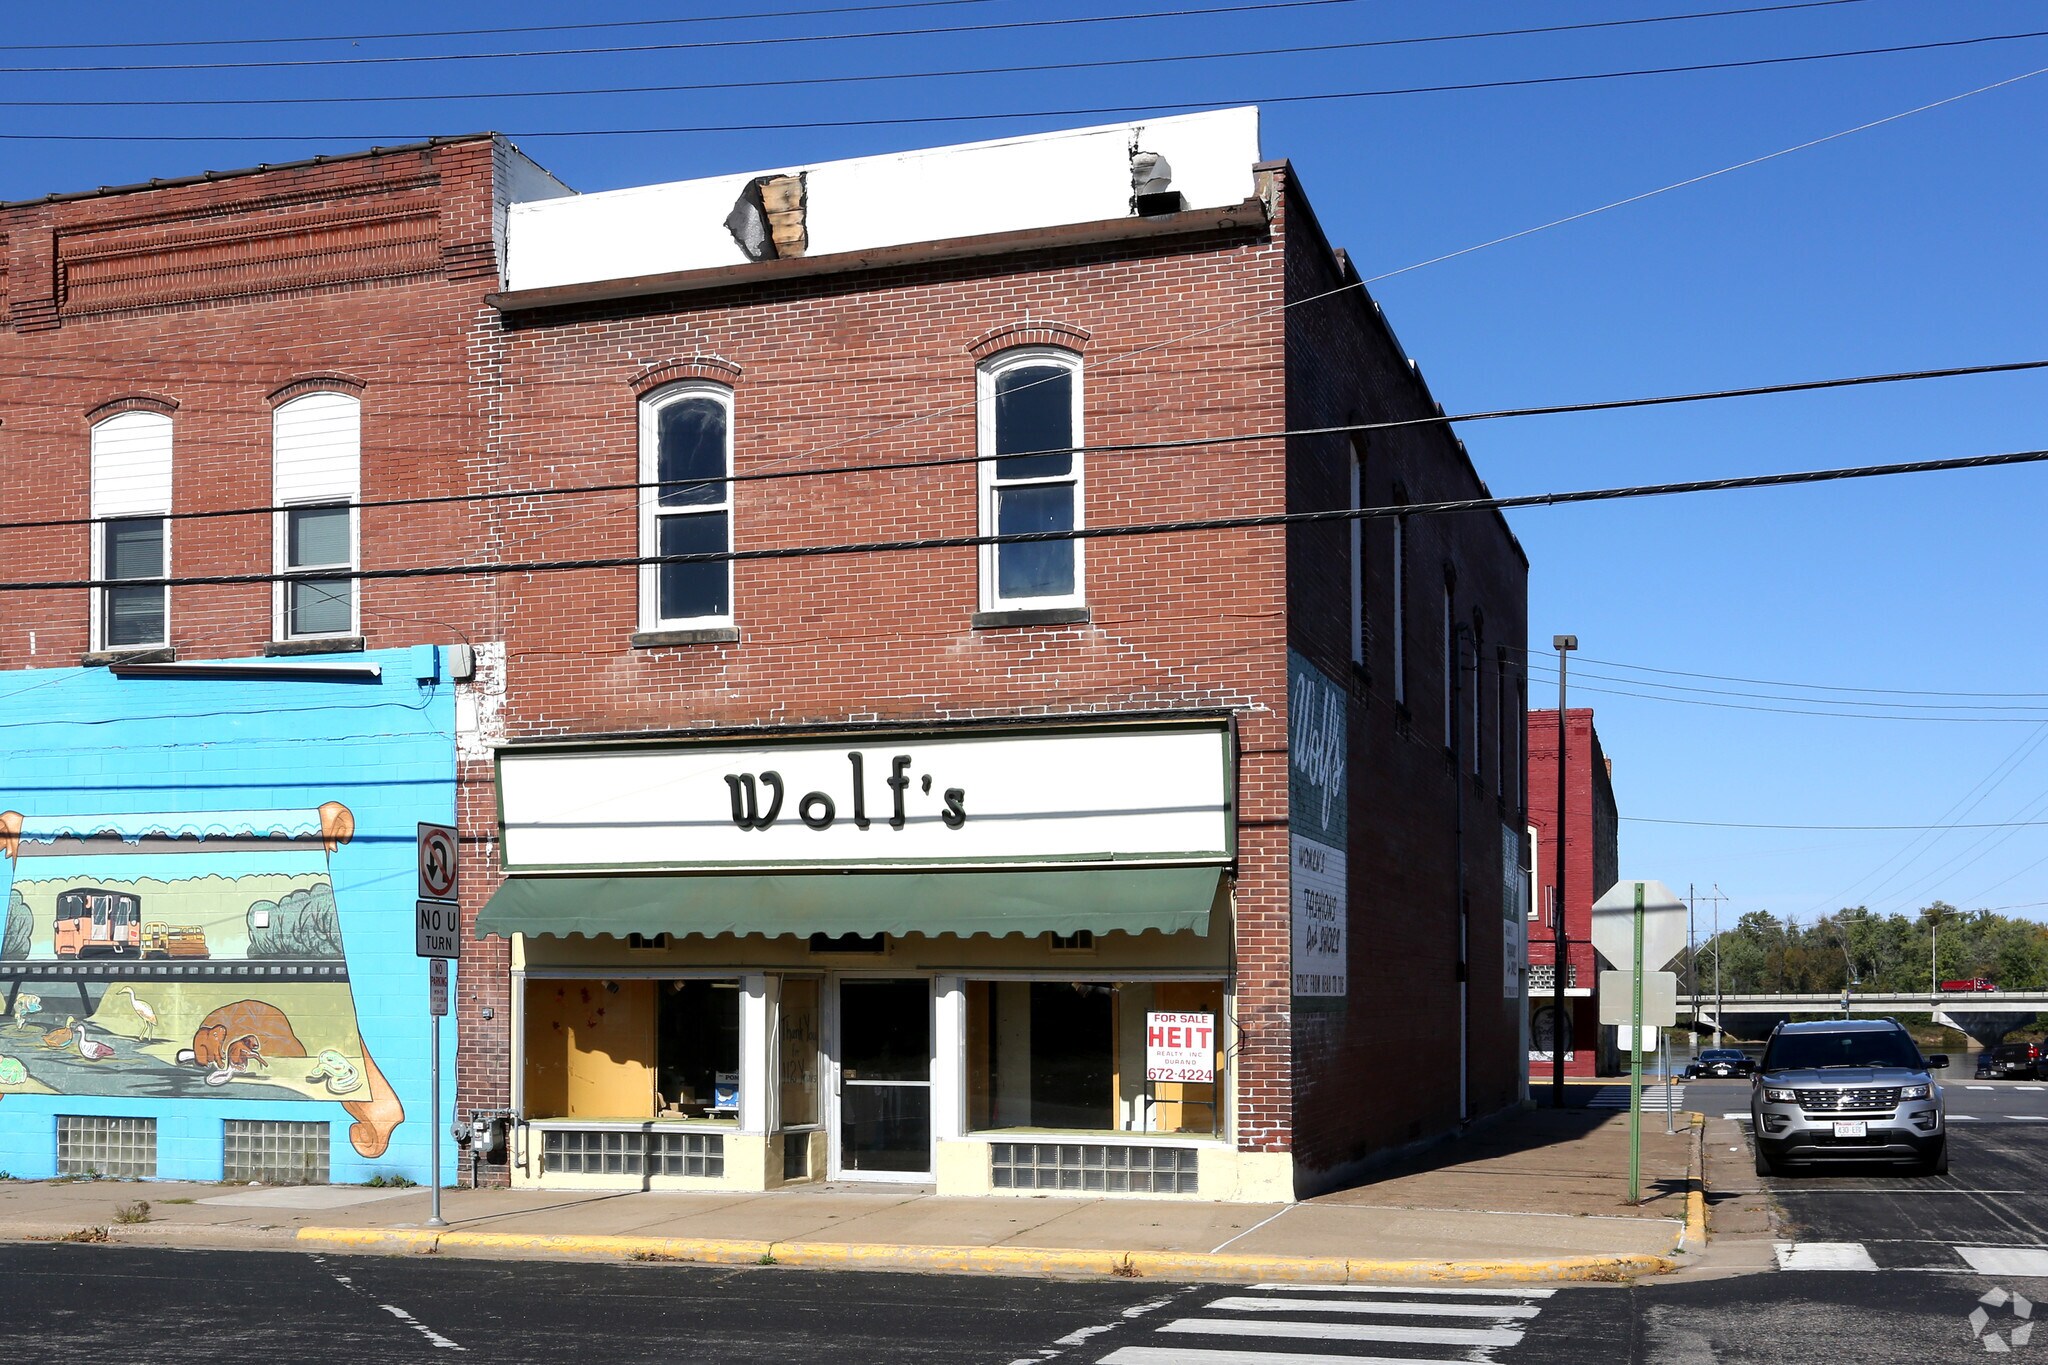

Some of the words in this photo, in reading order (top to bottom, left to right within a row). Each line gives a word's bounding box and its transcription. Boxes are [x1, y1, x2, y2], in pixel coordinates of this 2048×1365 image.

[724, 751, 967, 832] Wolf's
[421, 909, 441, 931] NO
[447, 912, 456, 932] U
[425, 935, 452, 951] TURN
[435, 963, 443, 975] NO
[431, 976, 447, 987] PARKING
[1154, 1014, 1176, 1023] FOR
[1180, 1014, 1208, 1024] SALE
[1148, 1026, 1212, 1049] HEIT
